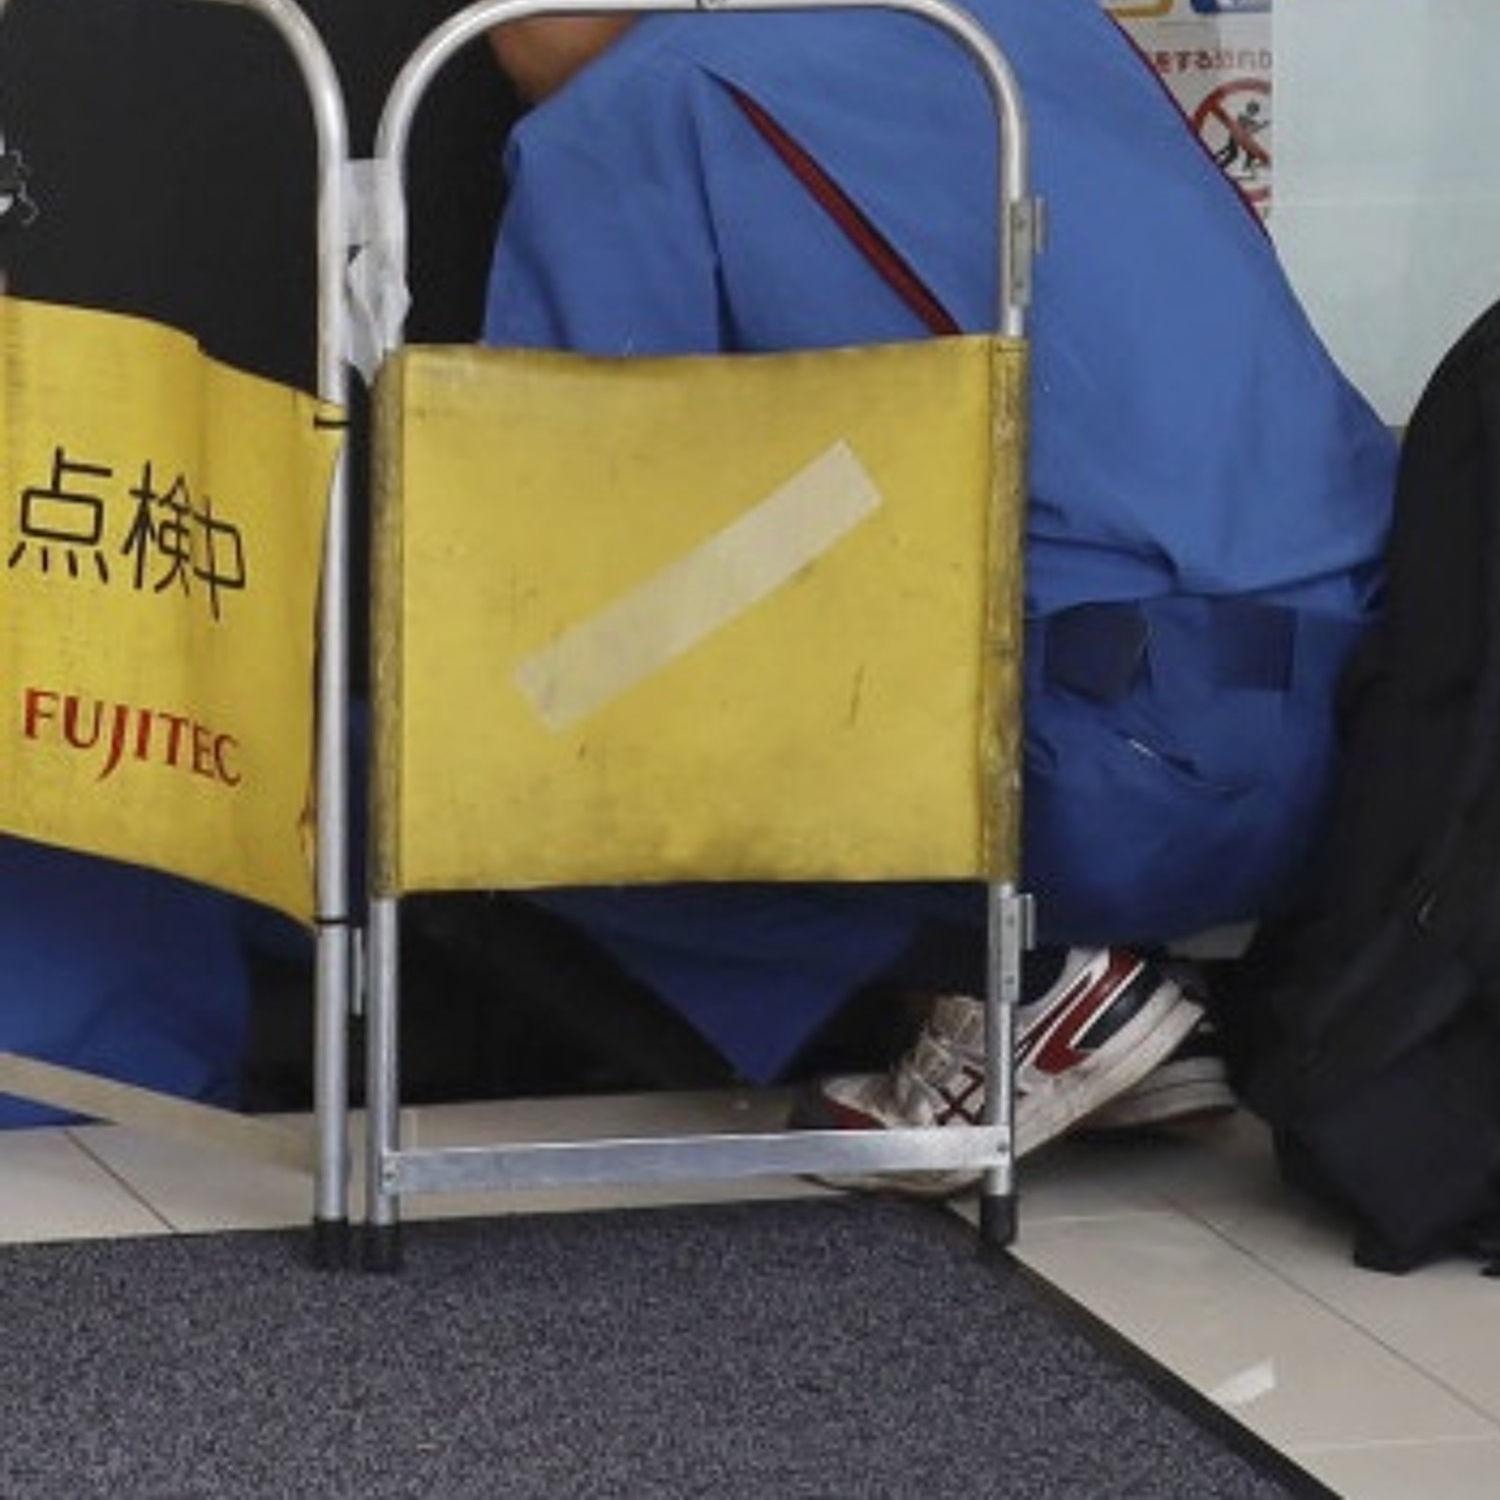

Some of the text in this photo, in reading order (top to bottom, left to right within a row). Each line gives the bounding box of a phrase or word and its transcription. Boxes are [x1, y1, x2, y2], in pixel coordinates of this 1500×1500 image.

[8, 447, 245, 622] 点検中
[24, 687, 243, 788] FUJITEC
